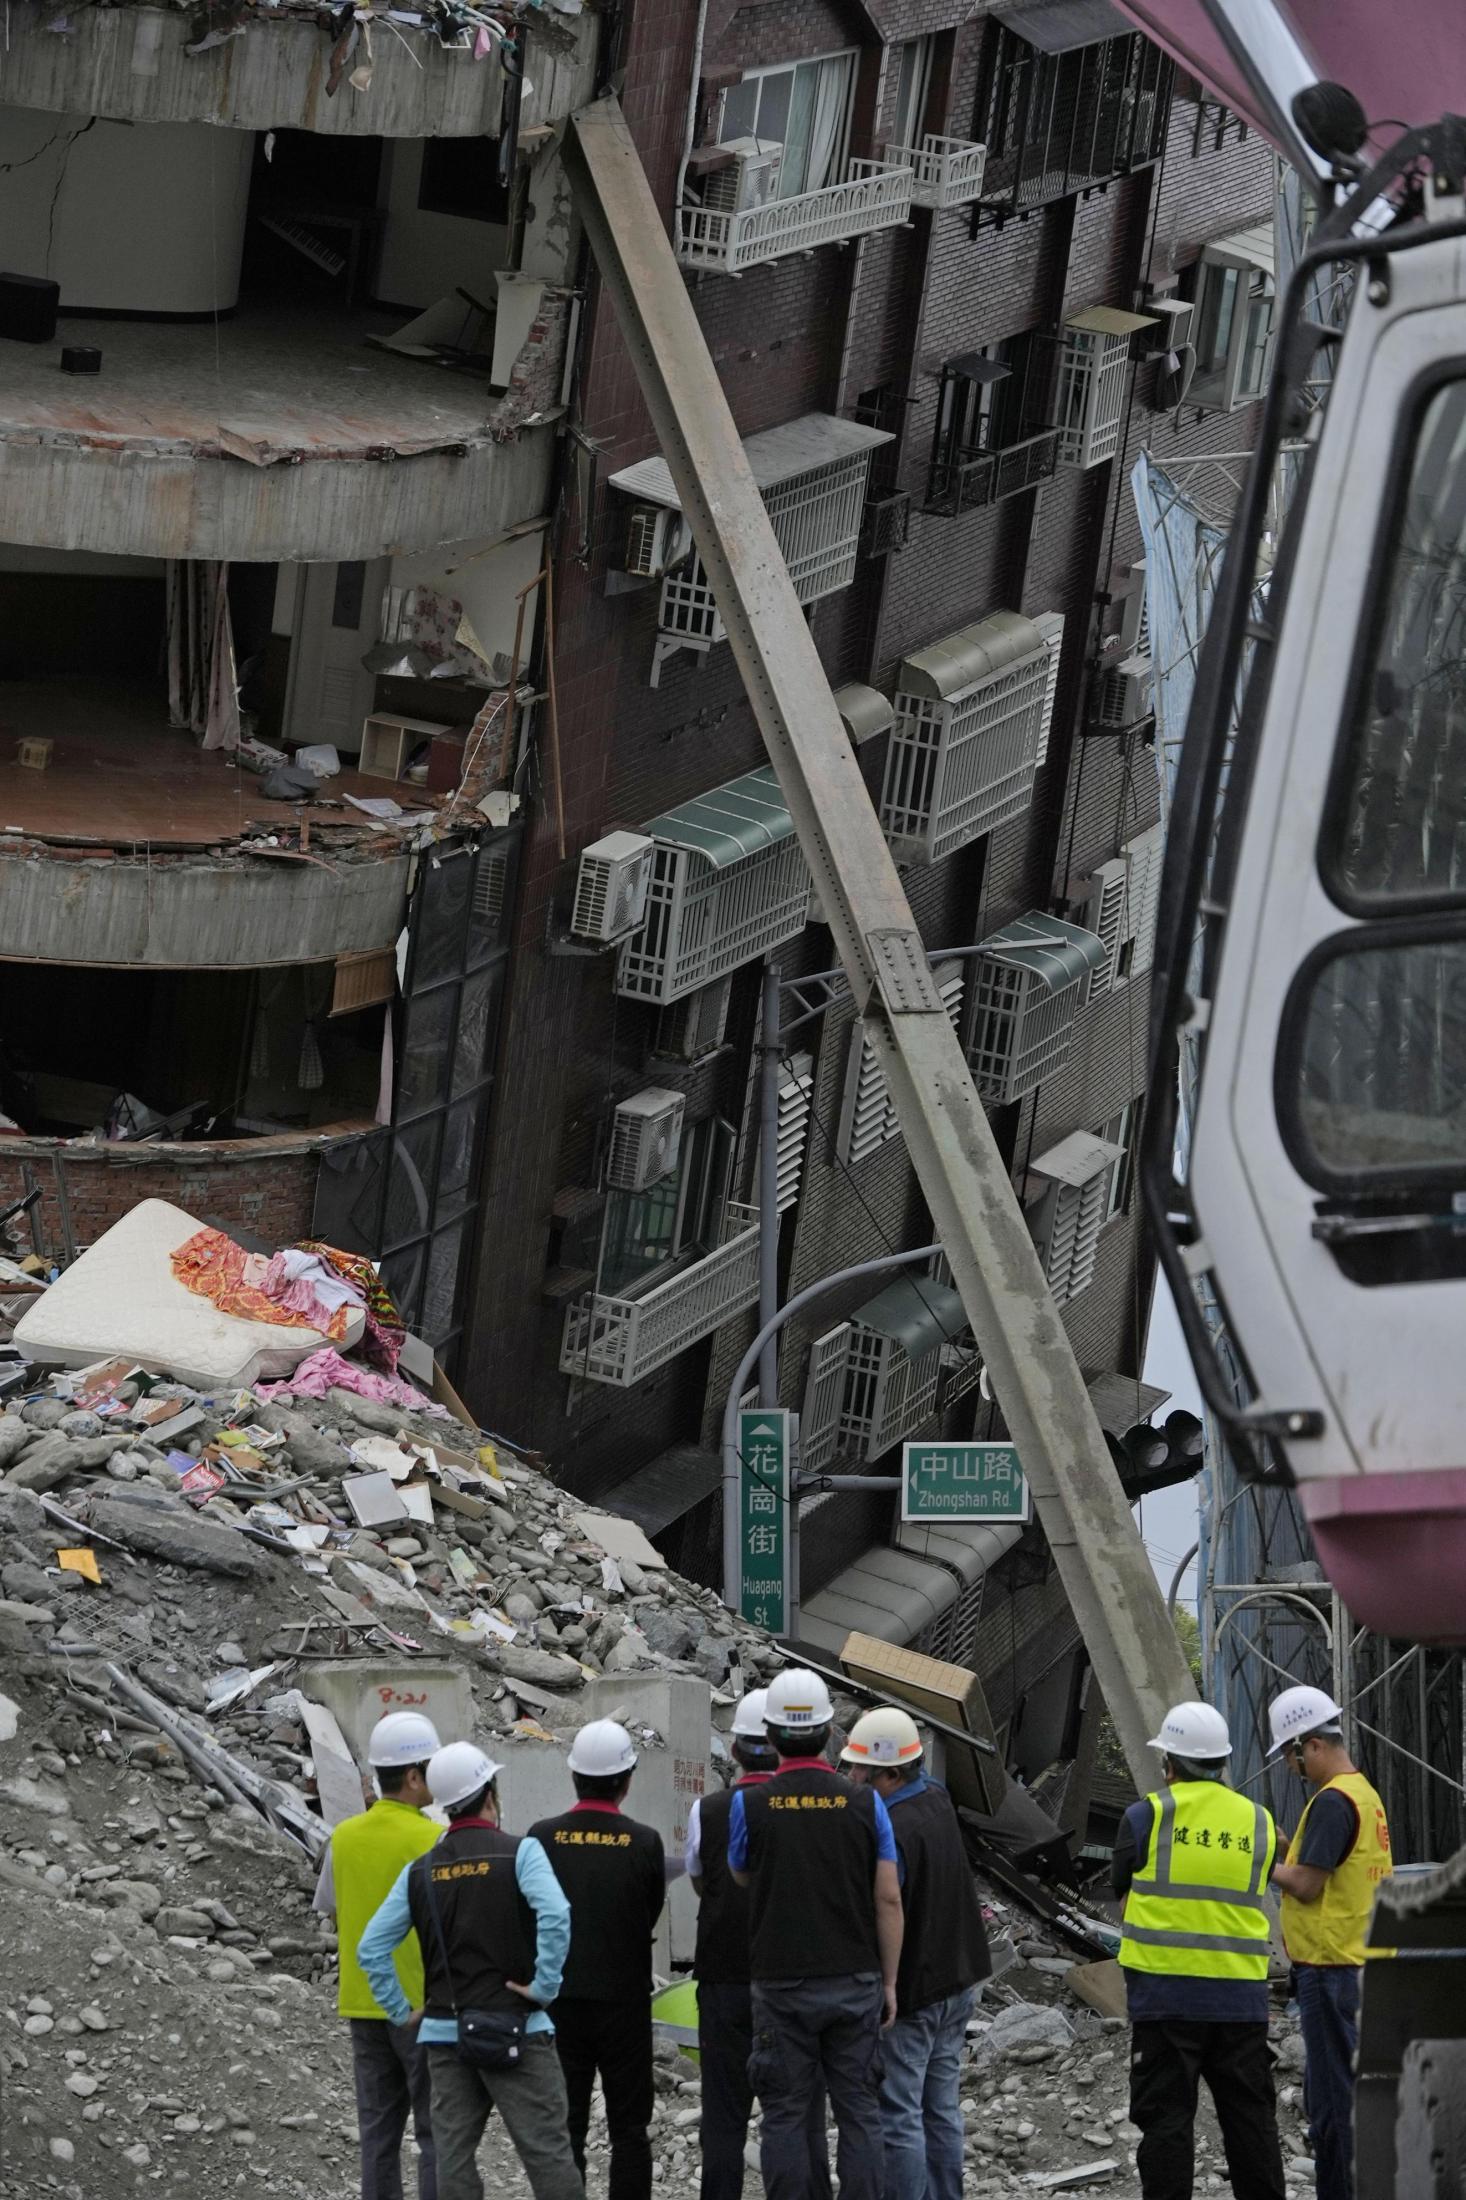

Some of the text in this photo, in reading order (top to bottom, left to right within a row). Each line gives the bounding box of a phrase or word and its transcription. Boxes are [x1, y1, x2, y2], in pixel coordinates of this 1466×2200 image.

[921, 1451, 1012, 1481] 中山路
[748, 1444, 777, 1555] 花崗街
[918, 1490, 1012, 1512] Zhongshan Rd.
[742, 1575, 782, 1600] Huagang
[754, 1606, 770, 1625] St.
[768, 1795, 848, 1810] 花蓮縣政府
[554, 1830, 632, 1847] 花蓮縣政府
[1174, 1826, 1252, 1853] 健達營造
